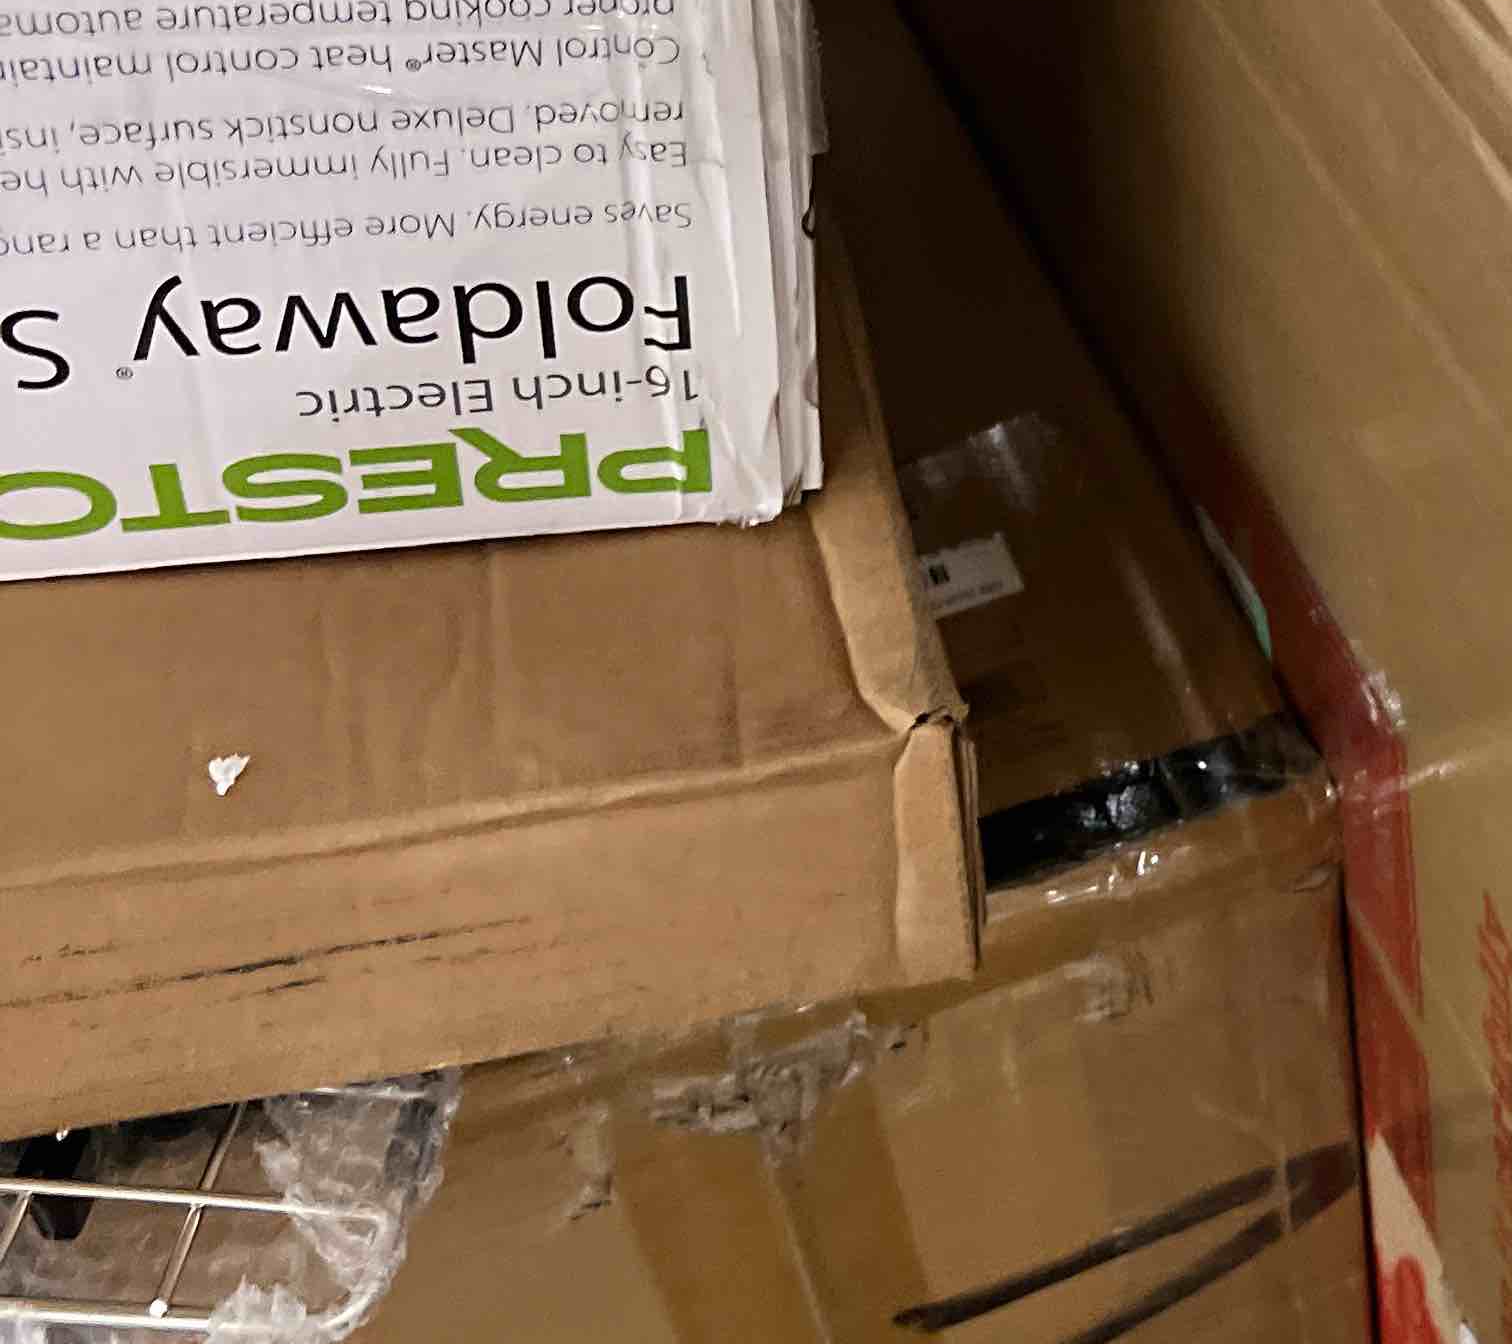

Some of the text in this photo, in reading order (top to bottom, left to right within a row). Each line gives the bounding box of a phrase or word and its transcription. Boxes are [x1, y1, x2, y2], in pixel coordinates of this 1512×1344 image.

[166, 47, 299, 83] control
[308, 42, 393, 74] heat
[556, 34, 681, 68] Control
[69, 114, 214, 151] surface,
[223, 110, 379, 147] nonstick
[391, 105, 515, 137] Deluxe
[525, 99, 684, 134] removed.
[369, 144, 449, 179] Fully
[461, 144, 562, 173] clean.
[573, 141, 607, 165] to
[618, 130, 687, 168] Easy
[60, 163, 144, 197] with
[154, 153, 359, 190] immersible
[365, 212, 455, 240] More
[466, 201, 593, 230] energy.
[604, 200, 692, 230] Saves
[83, 230, 101, 251] a
[114, 224, 198, 253] than
[207, 216, 354, 249] efficient
[295, 364, 699, 424] 16-inch Electric
[0, 426, 713, 542] PRESTO
